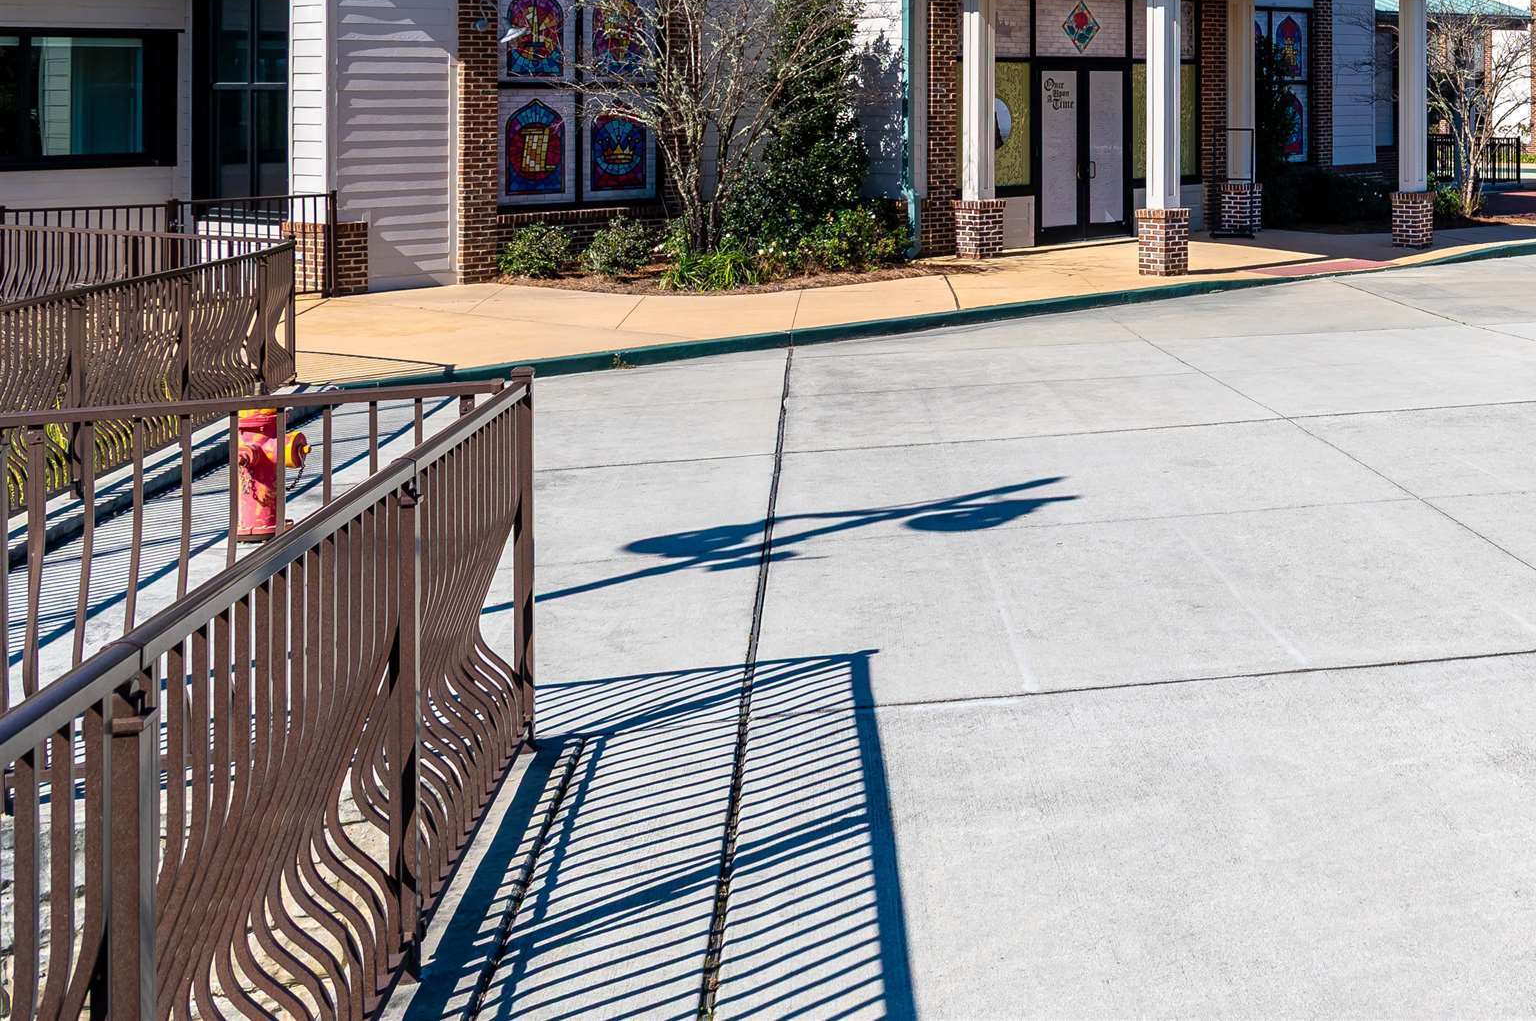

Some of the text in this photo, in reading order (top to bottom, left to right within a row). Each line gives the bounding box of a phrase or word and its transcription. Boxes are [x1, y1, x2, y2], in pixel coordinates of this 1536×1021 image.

[1044, 77, 1065, 91] Once
[1052, 90, 1070, 99] Upon
[1053, 98, 1074, 110] Time
